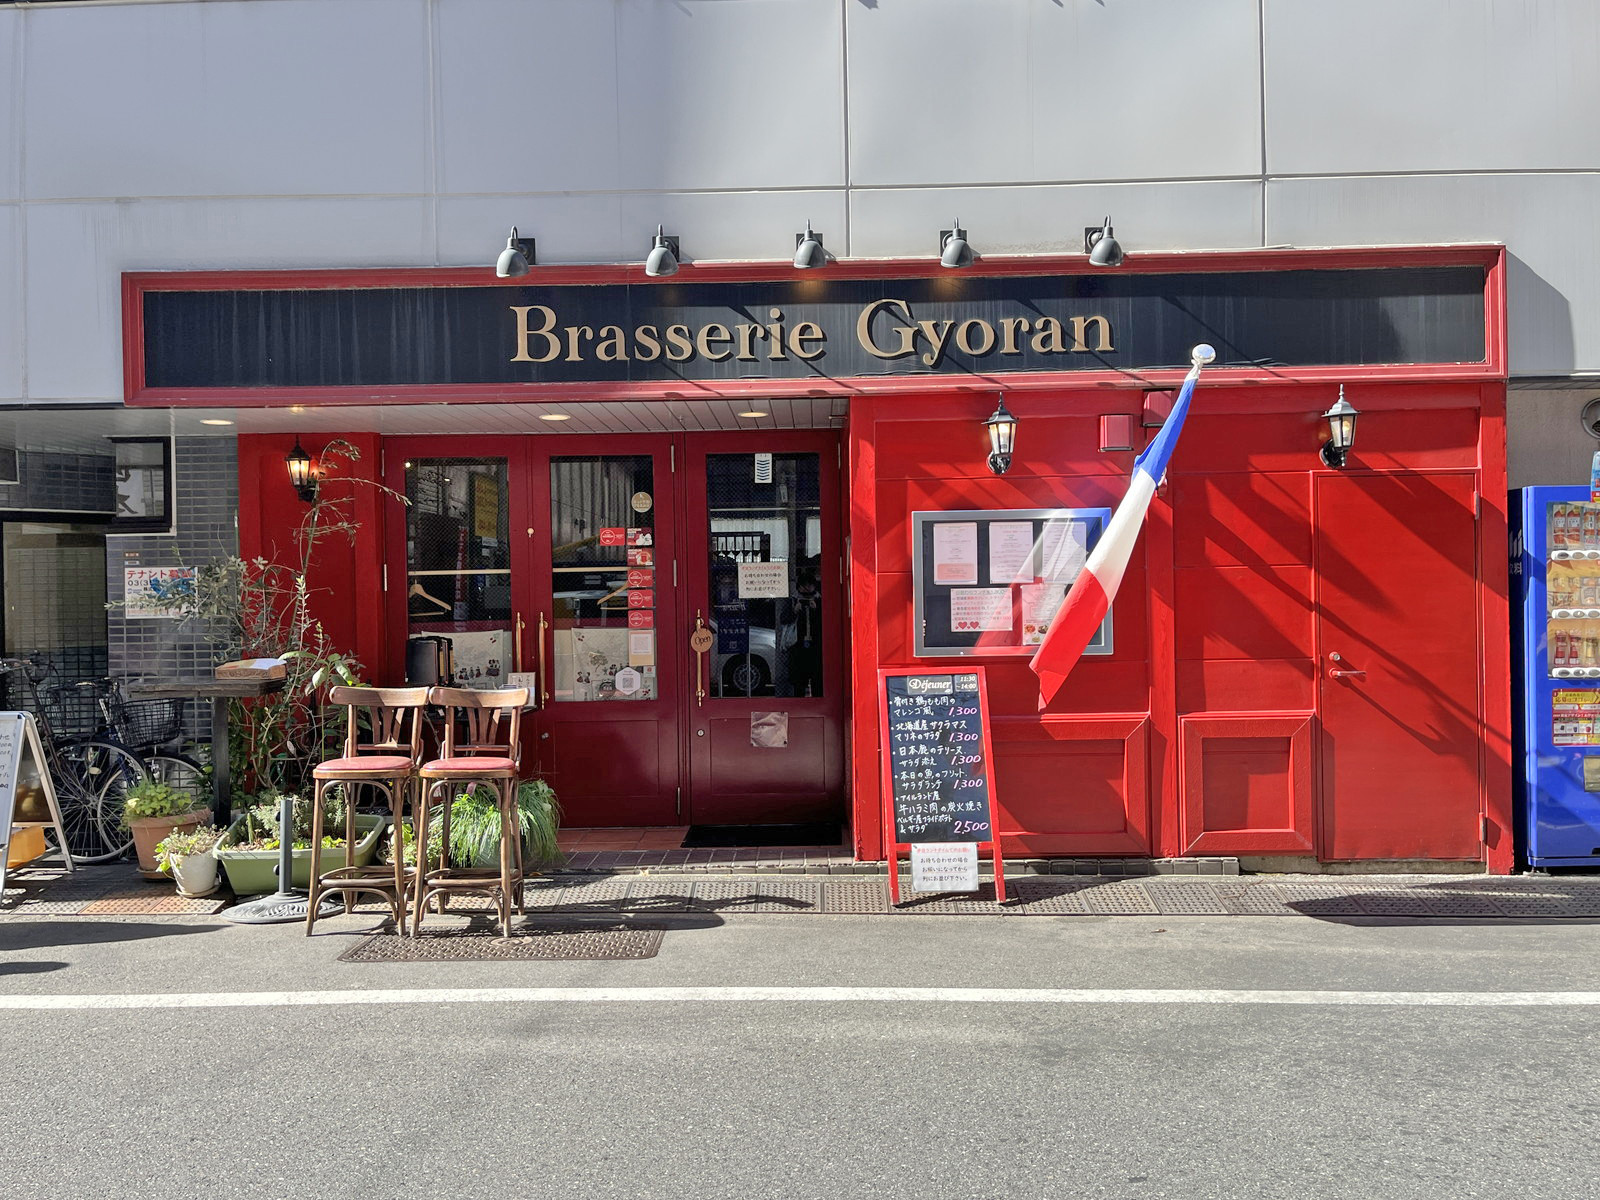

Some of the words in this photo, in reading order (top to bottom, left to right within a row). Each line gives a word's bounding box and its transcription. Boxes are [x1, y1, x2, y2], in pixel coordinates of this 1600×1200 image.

[510, 304, 824, 363] Brasserie
[856, 298, 1115, 367] Gyoran
[694, 635, 711, 646] Open
